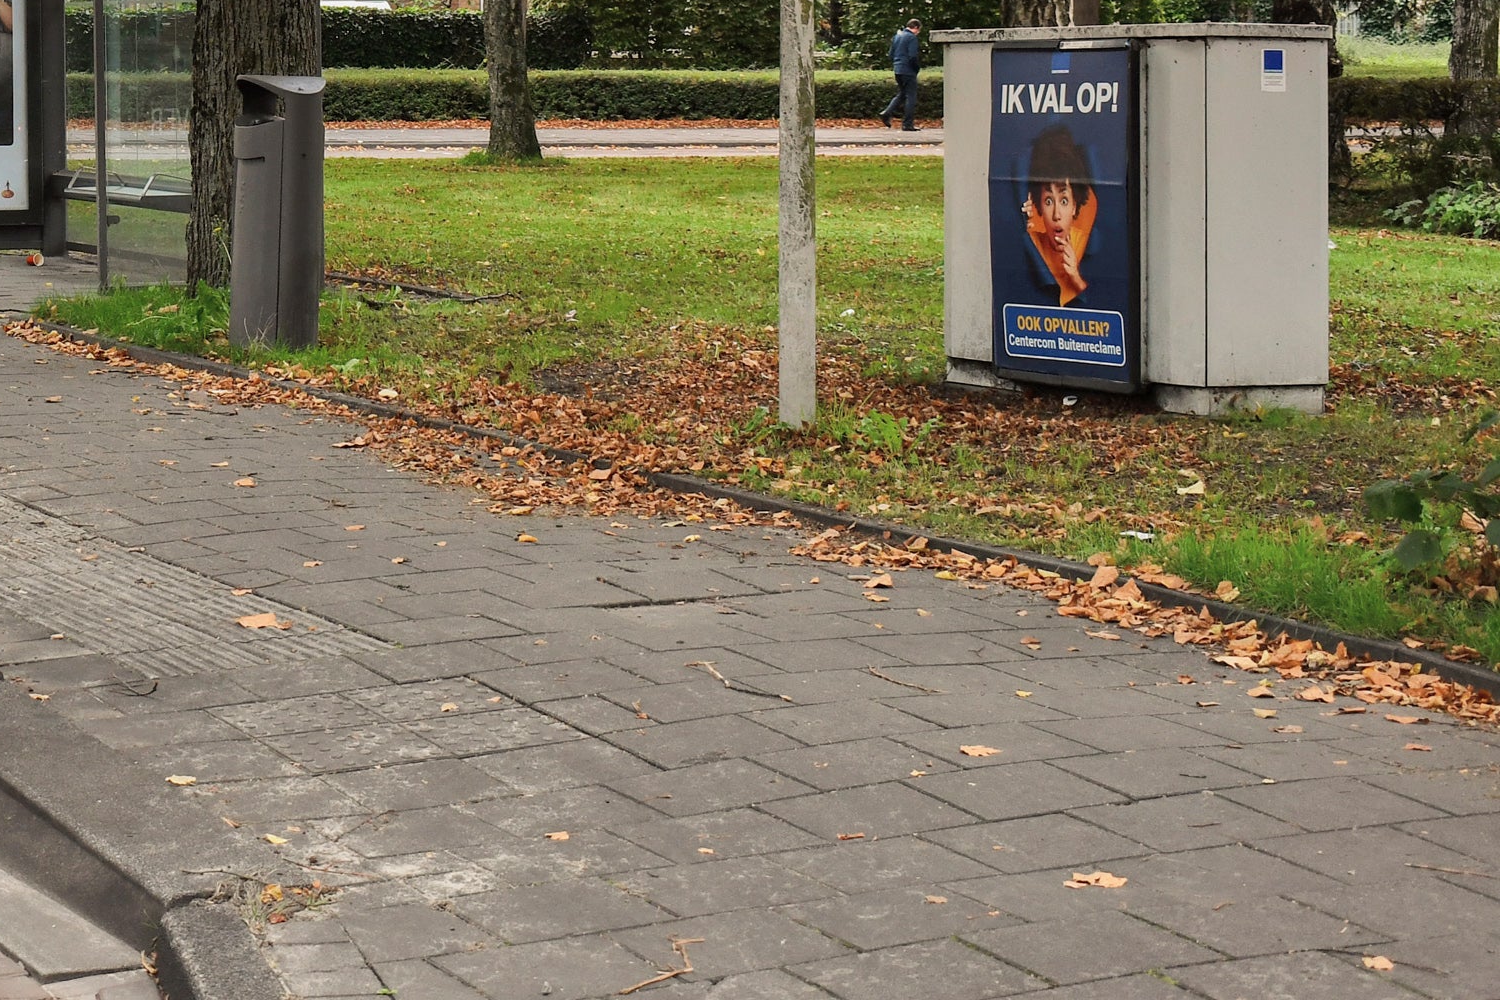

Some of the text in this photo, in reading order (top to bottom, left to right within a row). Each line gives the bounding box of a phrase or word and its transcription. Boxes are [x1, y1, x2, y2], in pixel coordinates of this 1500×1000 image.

[1001, 82, 1119, 113] IK VAL OP!
[1017, 315, 1110, 337] OOK OPVALLEN?
[1008, 333, 1122, 356] Centercom Buitenreclame
